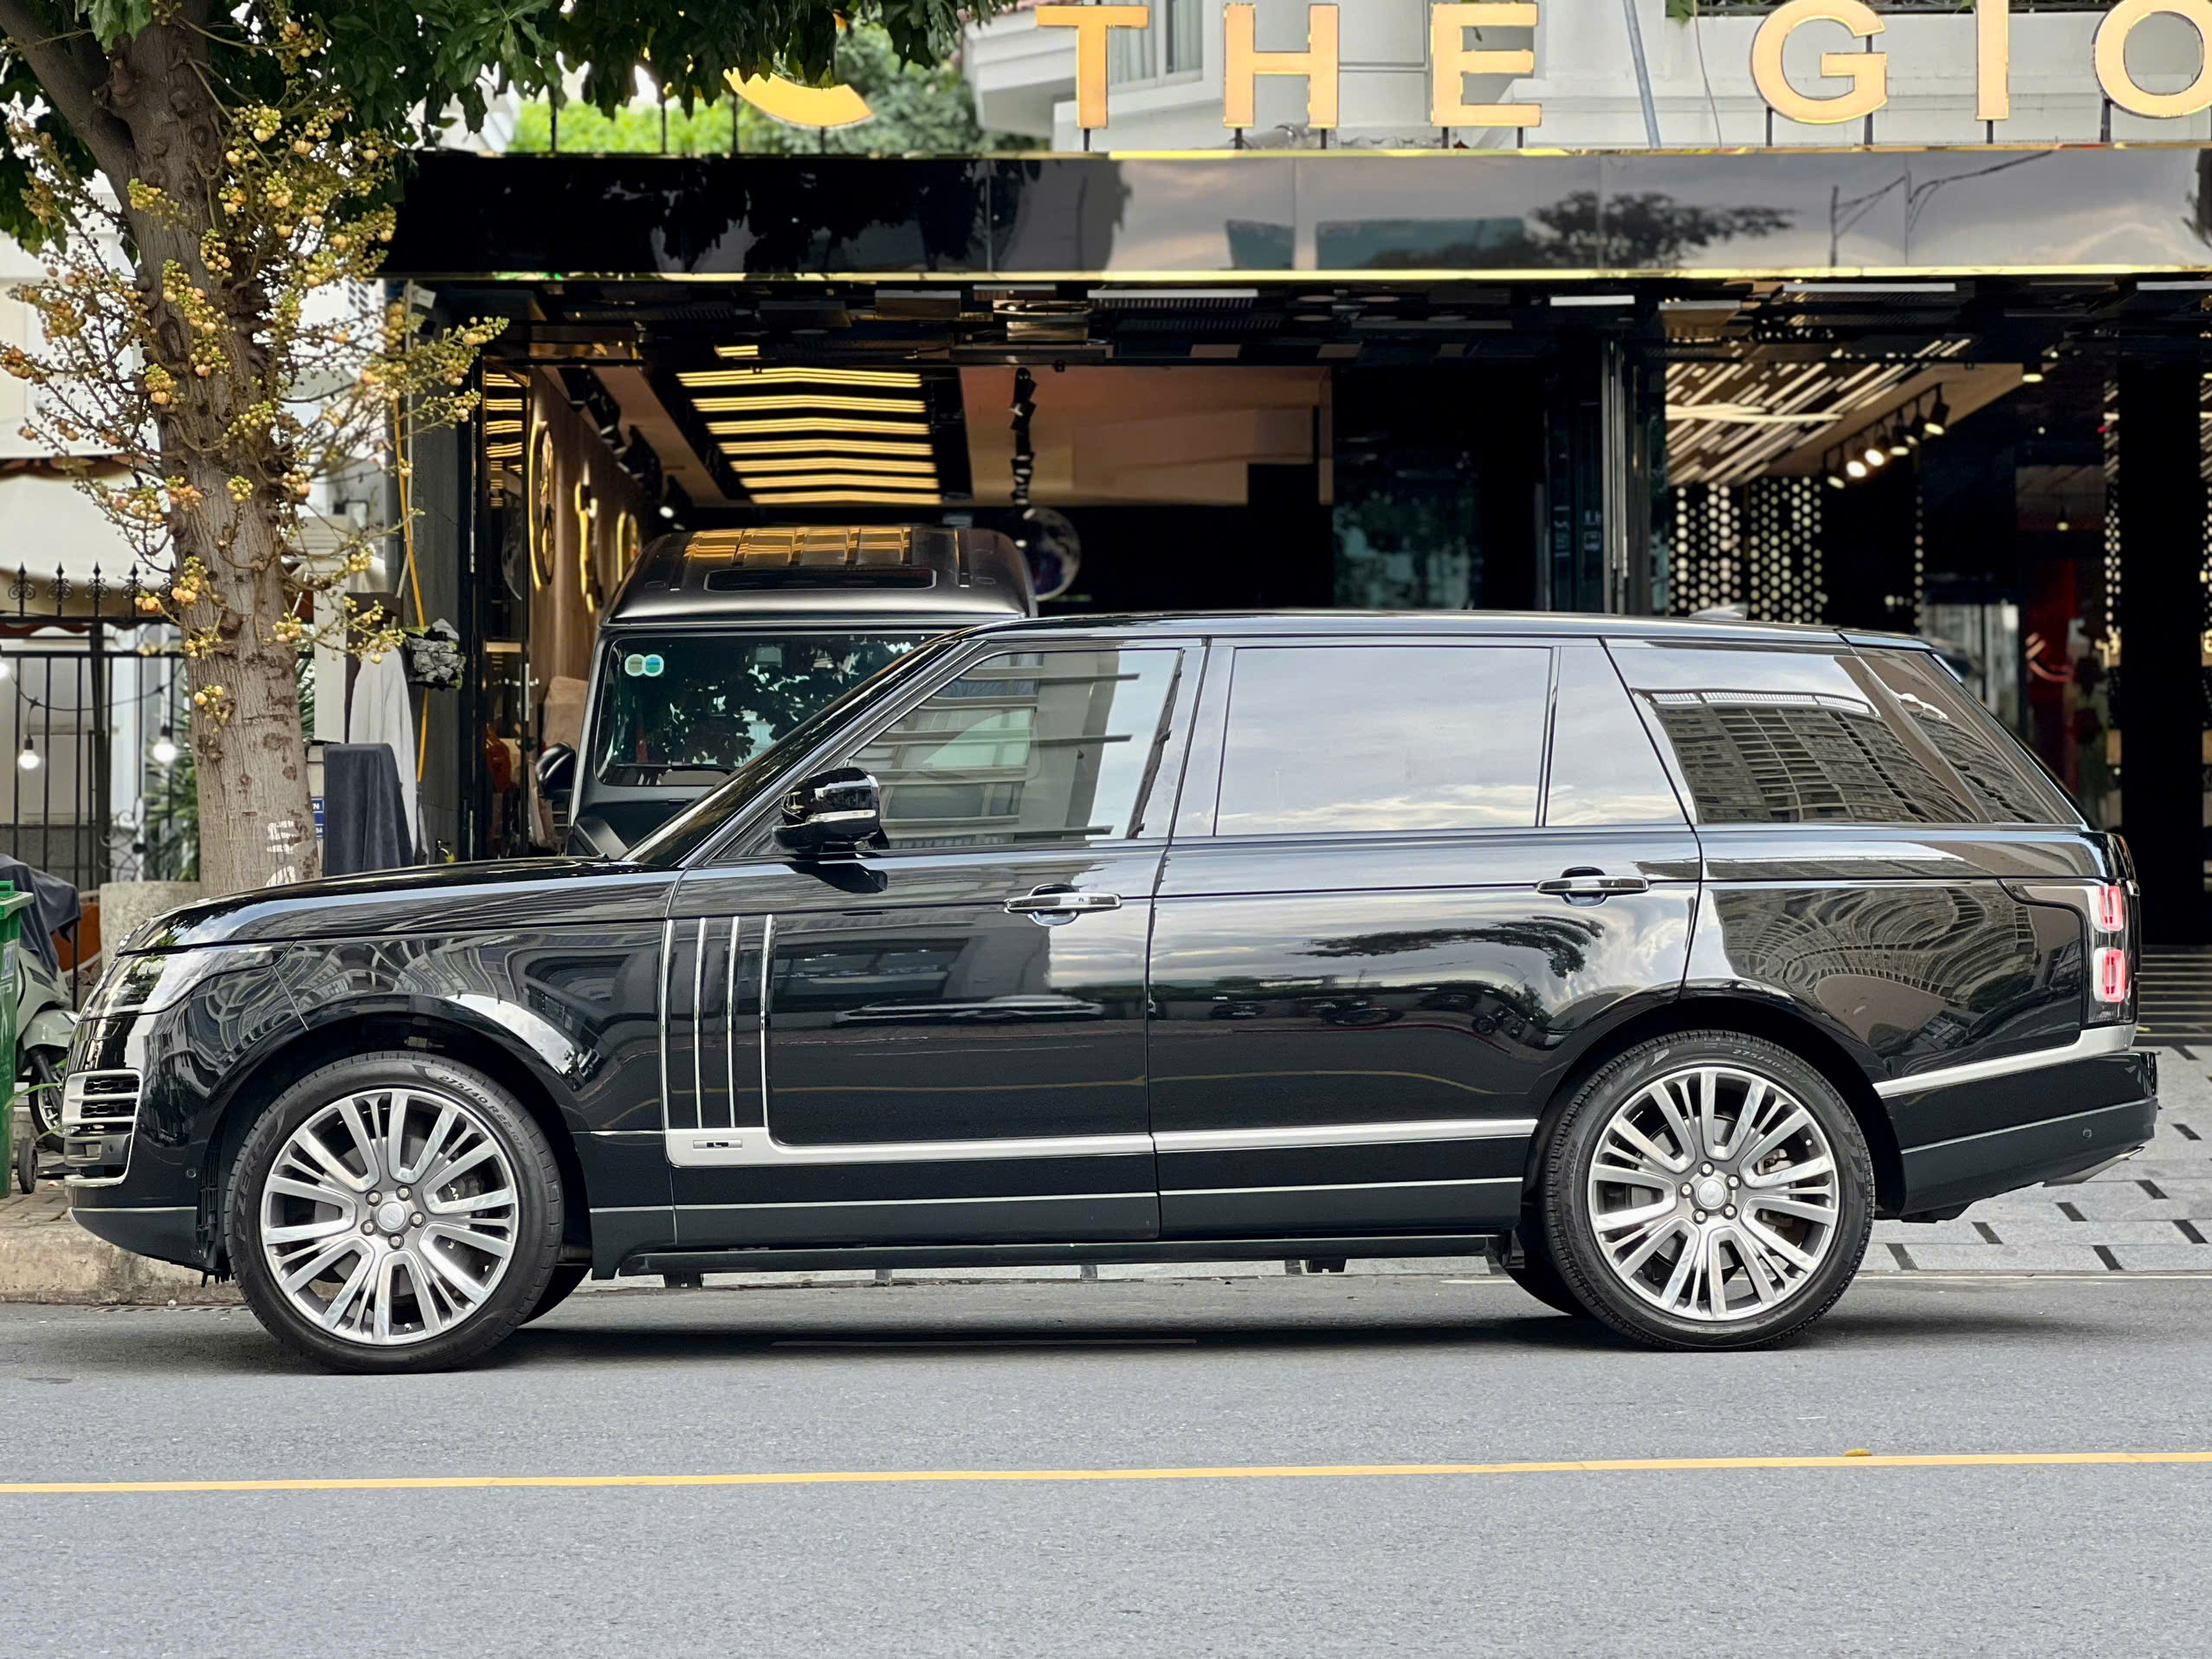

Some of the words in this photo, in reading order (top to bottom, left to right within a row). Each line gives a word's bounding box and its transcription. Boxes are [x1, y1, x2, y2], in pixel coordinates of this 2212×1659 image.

[1038, 2, 1543, 131] THE
[1749, 0, 2212, 124] GIO
[439, 1075, 488, 1102] 275/40
